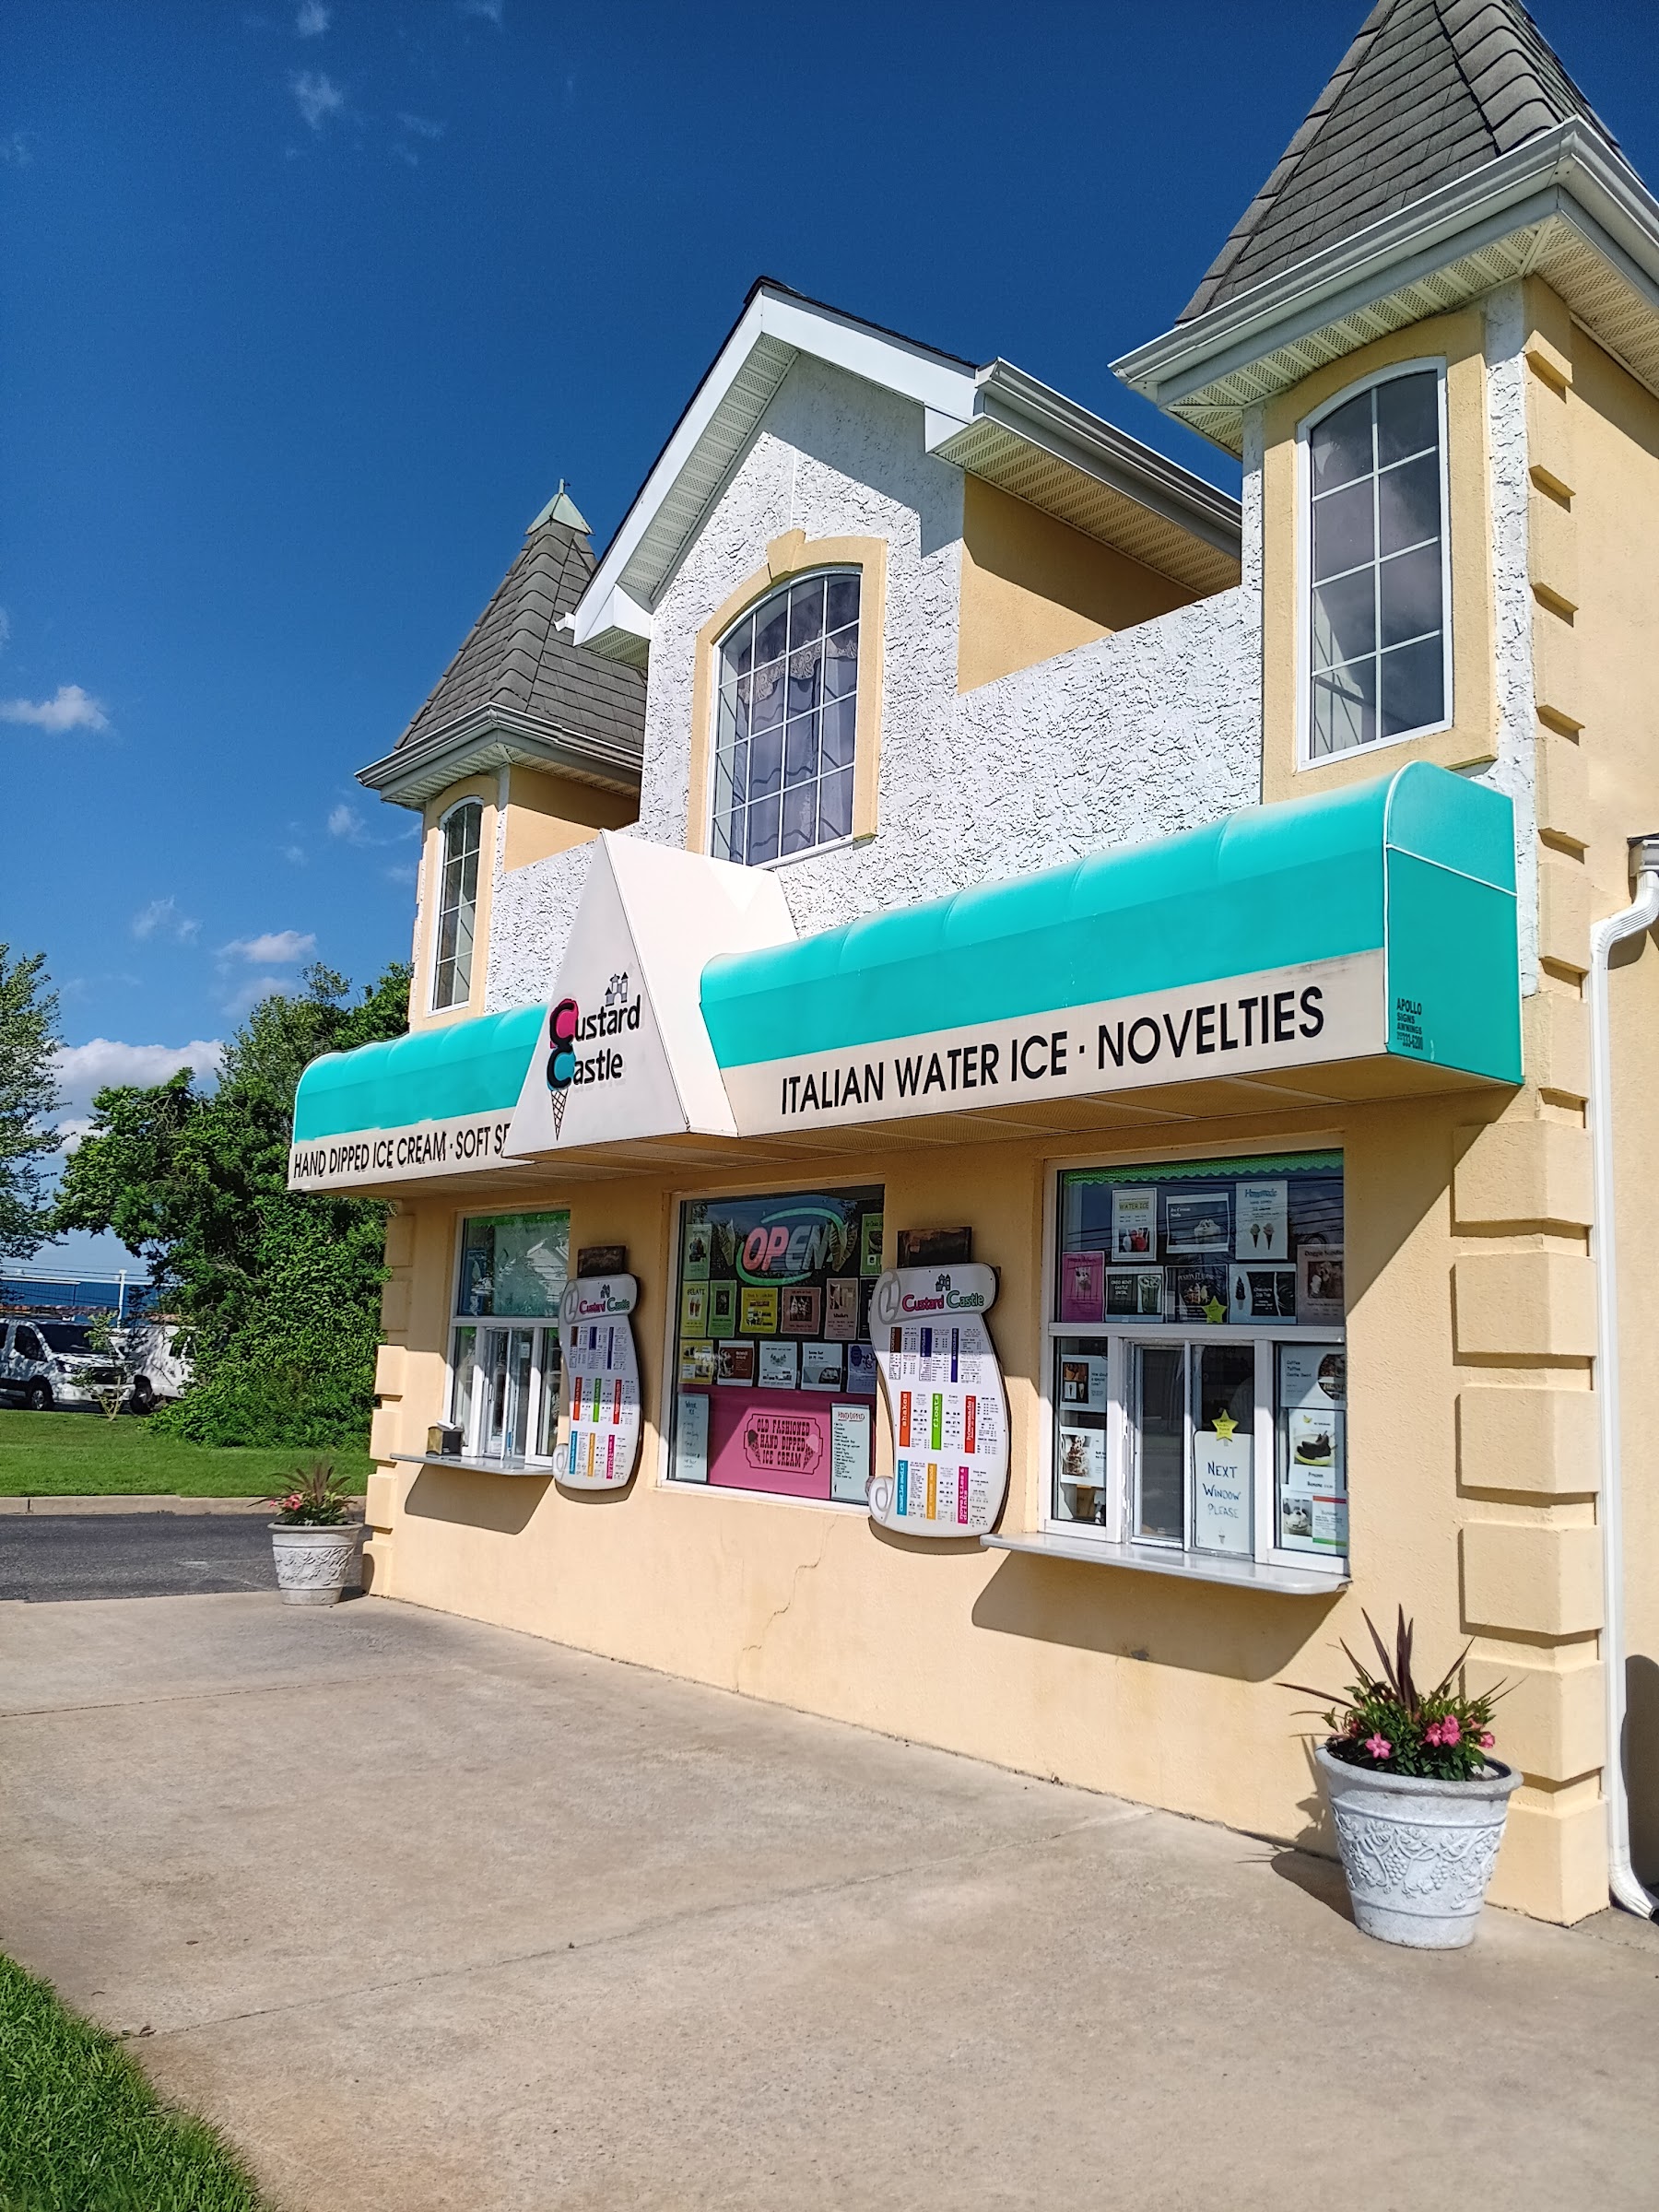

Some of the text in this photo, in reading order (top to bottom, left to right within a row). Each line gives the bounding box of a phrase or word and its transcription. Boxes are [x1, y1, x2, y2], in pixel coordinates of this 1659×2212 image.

[1396, 997, 1422, 1015] APOLLO
[549, 994, 641, 1043] Custard
[1396, 1012, 1415, 1024] SIGNS
[782, 985, 1324, 1115] ITALIAN WATER ICE NOVELTIES
[547, 1045, 623, 1088] Castle
[293, 1150, 326, 1178] HAND
[329, 1144, 370, 1173] DIPPED
[372, 1139, 394, 1169] ICE
[396, 1131, 447, 1166] CREAM
[455, 1125, 491, 1159] SOFT
[742, 1225, 831, 1272] OPEN
[606, 1297, 630, 1312] Castle
[902, 1289, 984, 1312] Custard Castle
[757, 1418, 810, 1436] OLD FASHIONED
[759, 1433, 806, 1453] HAND DIPPED
[762, 1450, 801, 1467] ICE CREAM
[1207, 1460, 1238, 1479] NEXT
[1202, 1483, 1241, 1500] WINDOW
[1207, 1503, 1239, 1519] PLEASE
